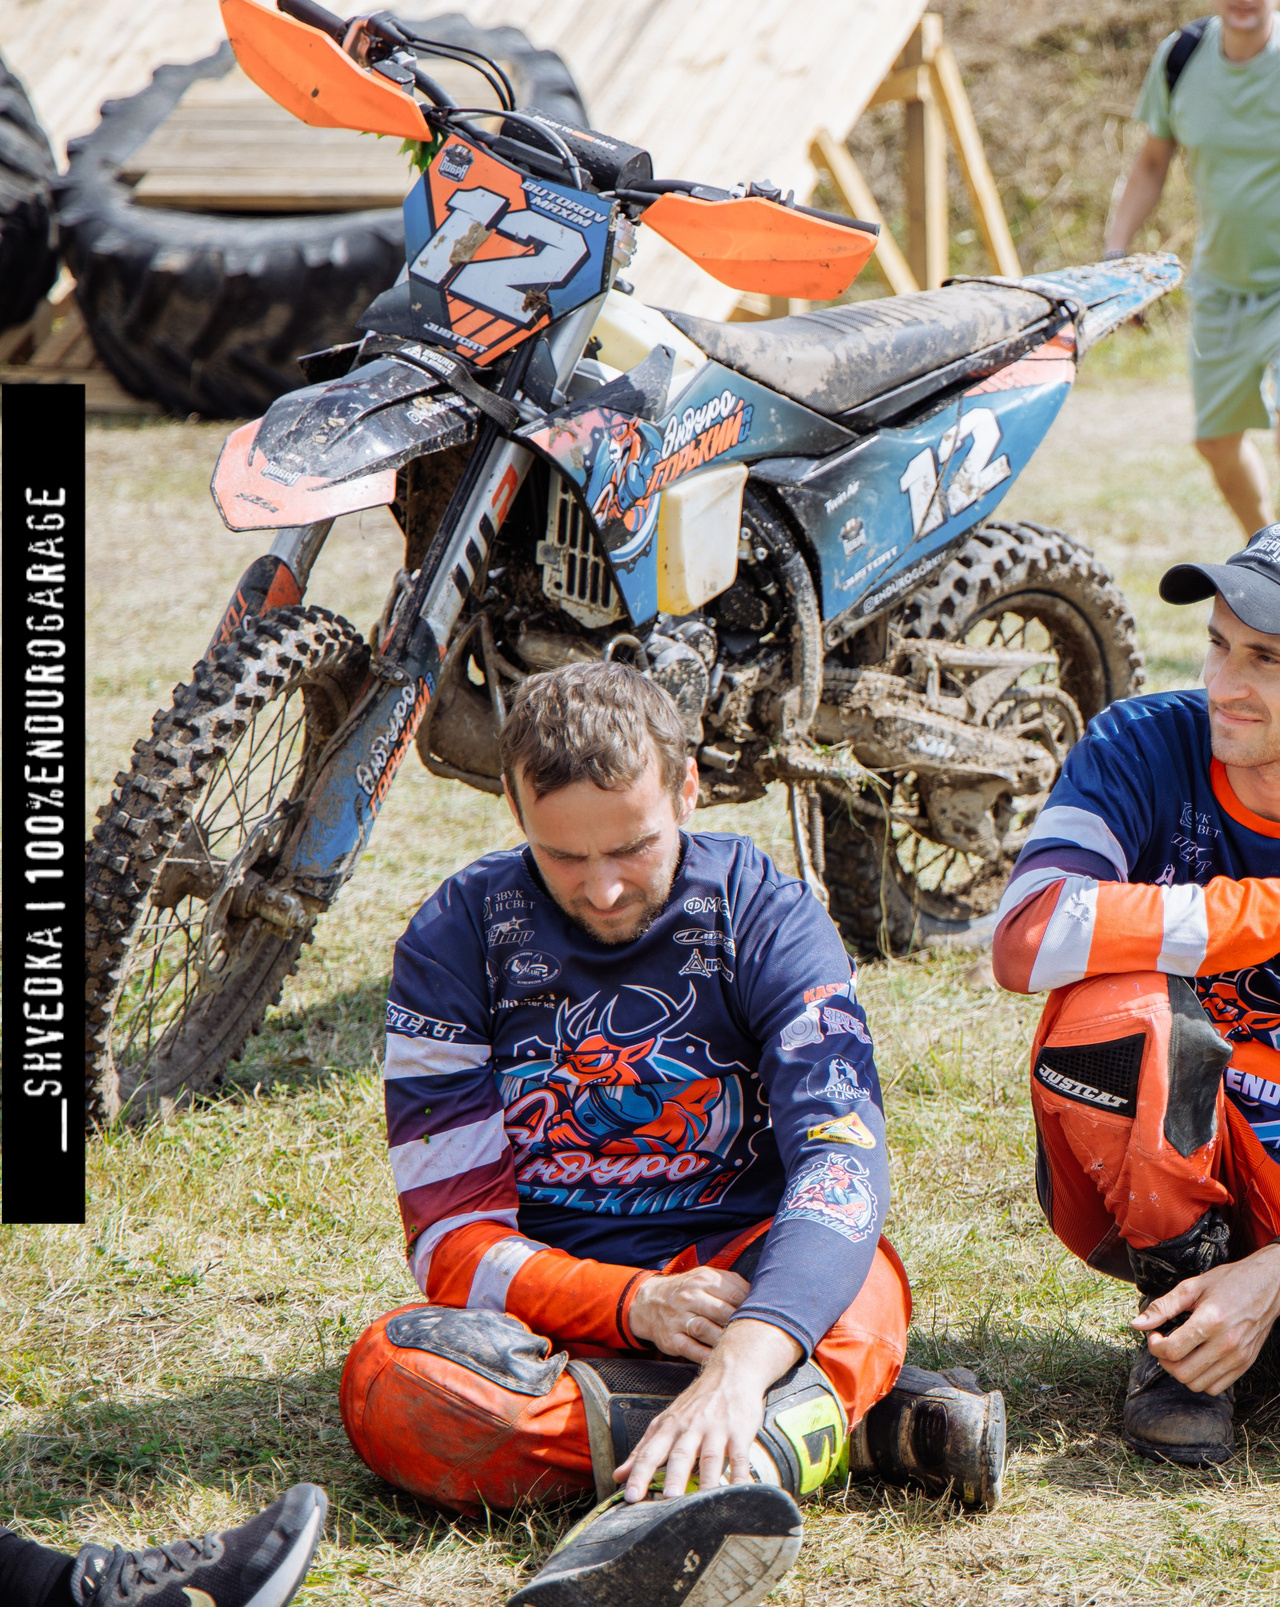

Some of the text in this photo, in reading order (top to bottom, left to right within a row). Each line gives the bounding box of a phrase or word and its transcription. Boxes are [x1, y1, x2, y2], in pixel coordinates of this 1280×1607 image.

[593, 138, 618, 151] RACE
[519, 180, 608, 224] BUTOROV
[529, 196, 595, 228] MAXIM
[410, 187, 590, 324] 12
[422, 348, 458, 371] ENDURO
[423, 322, 488, 353] JUSTCAT
[661, 389, 738, 458] Эндуро
[644, 398, 745, 498] ГОРЬКИЙ
[899, 407, 1012, 542] 12
[356, 682, 417, 796] Эндуро
[493, 889, 524, 903] ЗВУК
[495, 899, 536, 912] И СВЕТ
[1038, 1063, 1129, 1108] JUSTCAT
